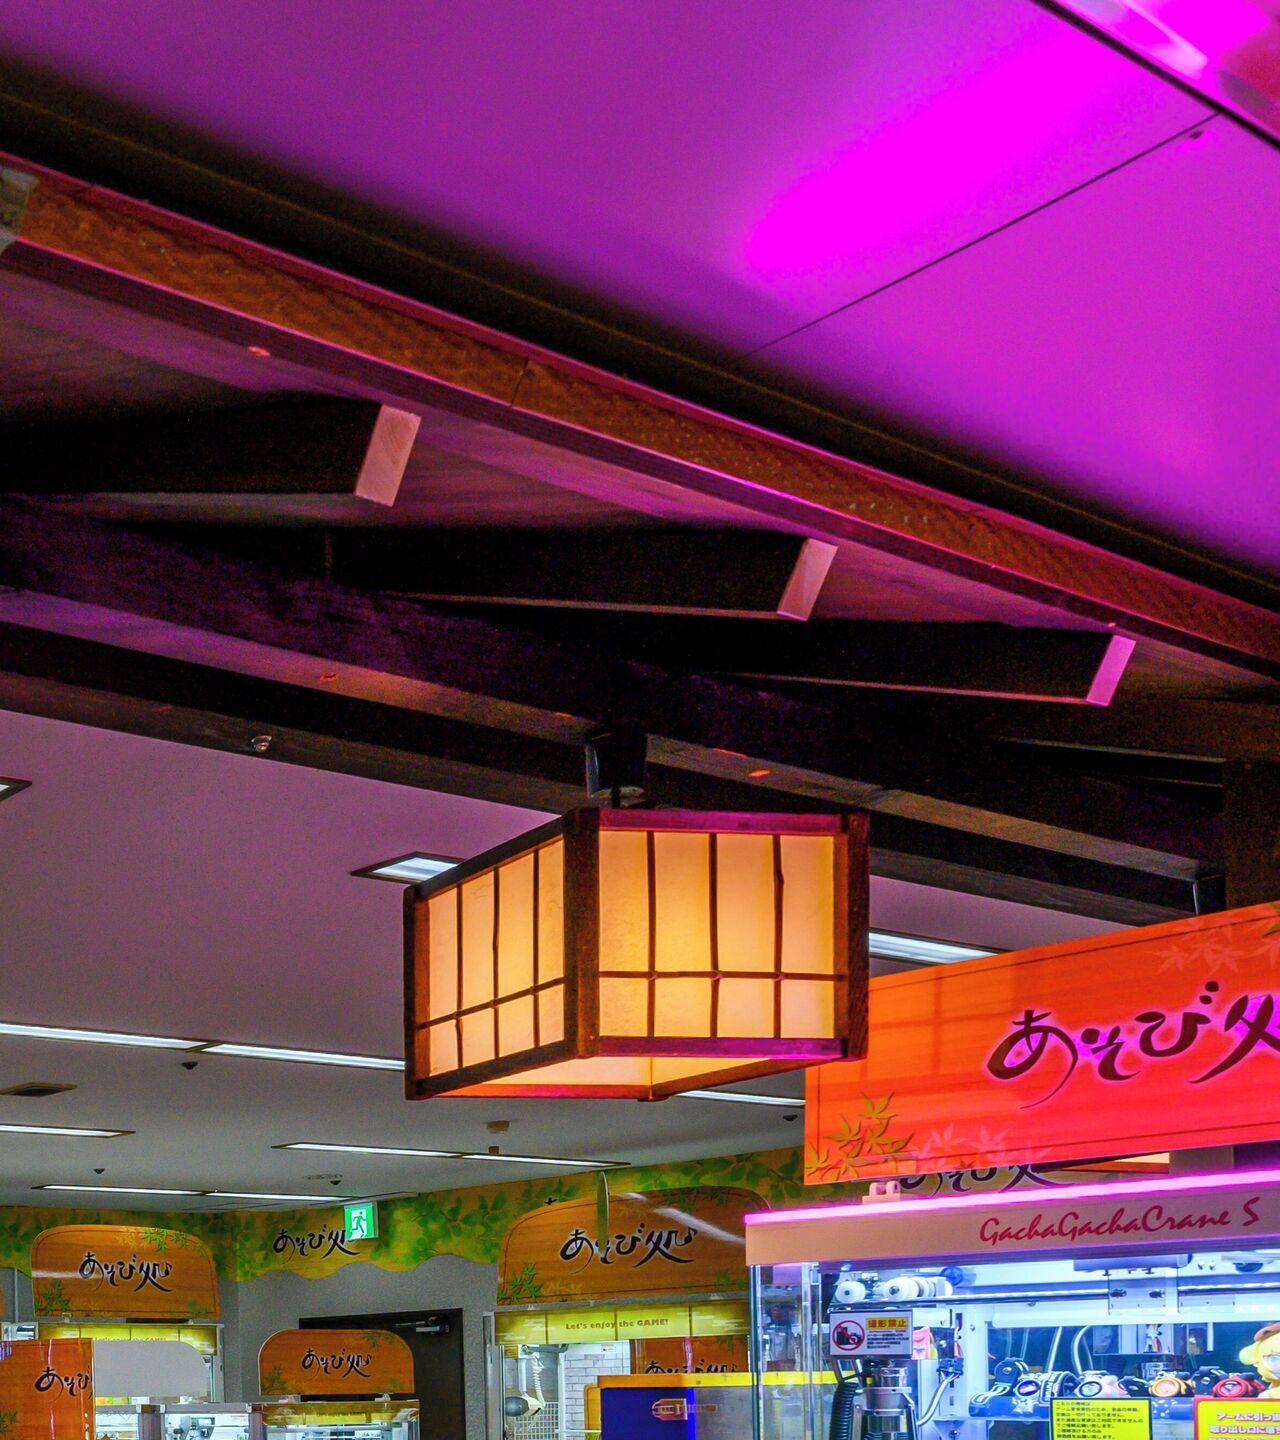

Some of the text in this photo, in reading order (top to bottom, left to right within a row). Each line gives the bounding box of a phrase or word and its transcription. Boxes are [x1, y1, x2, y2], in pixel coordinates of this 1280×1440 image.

[1230, 1197, 1261, 1229] S
[78, 1249, 174, 1293] あそび処
[301, 1347, 373, 1379] あそび処
